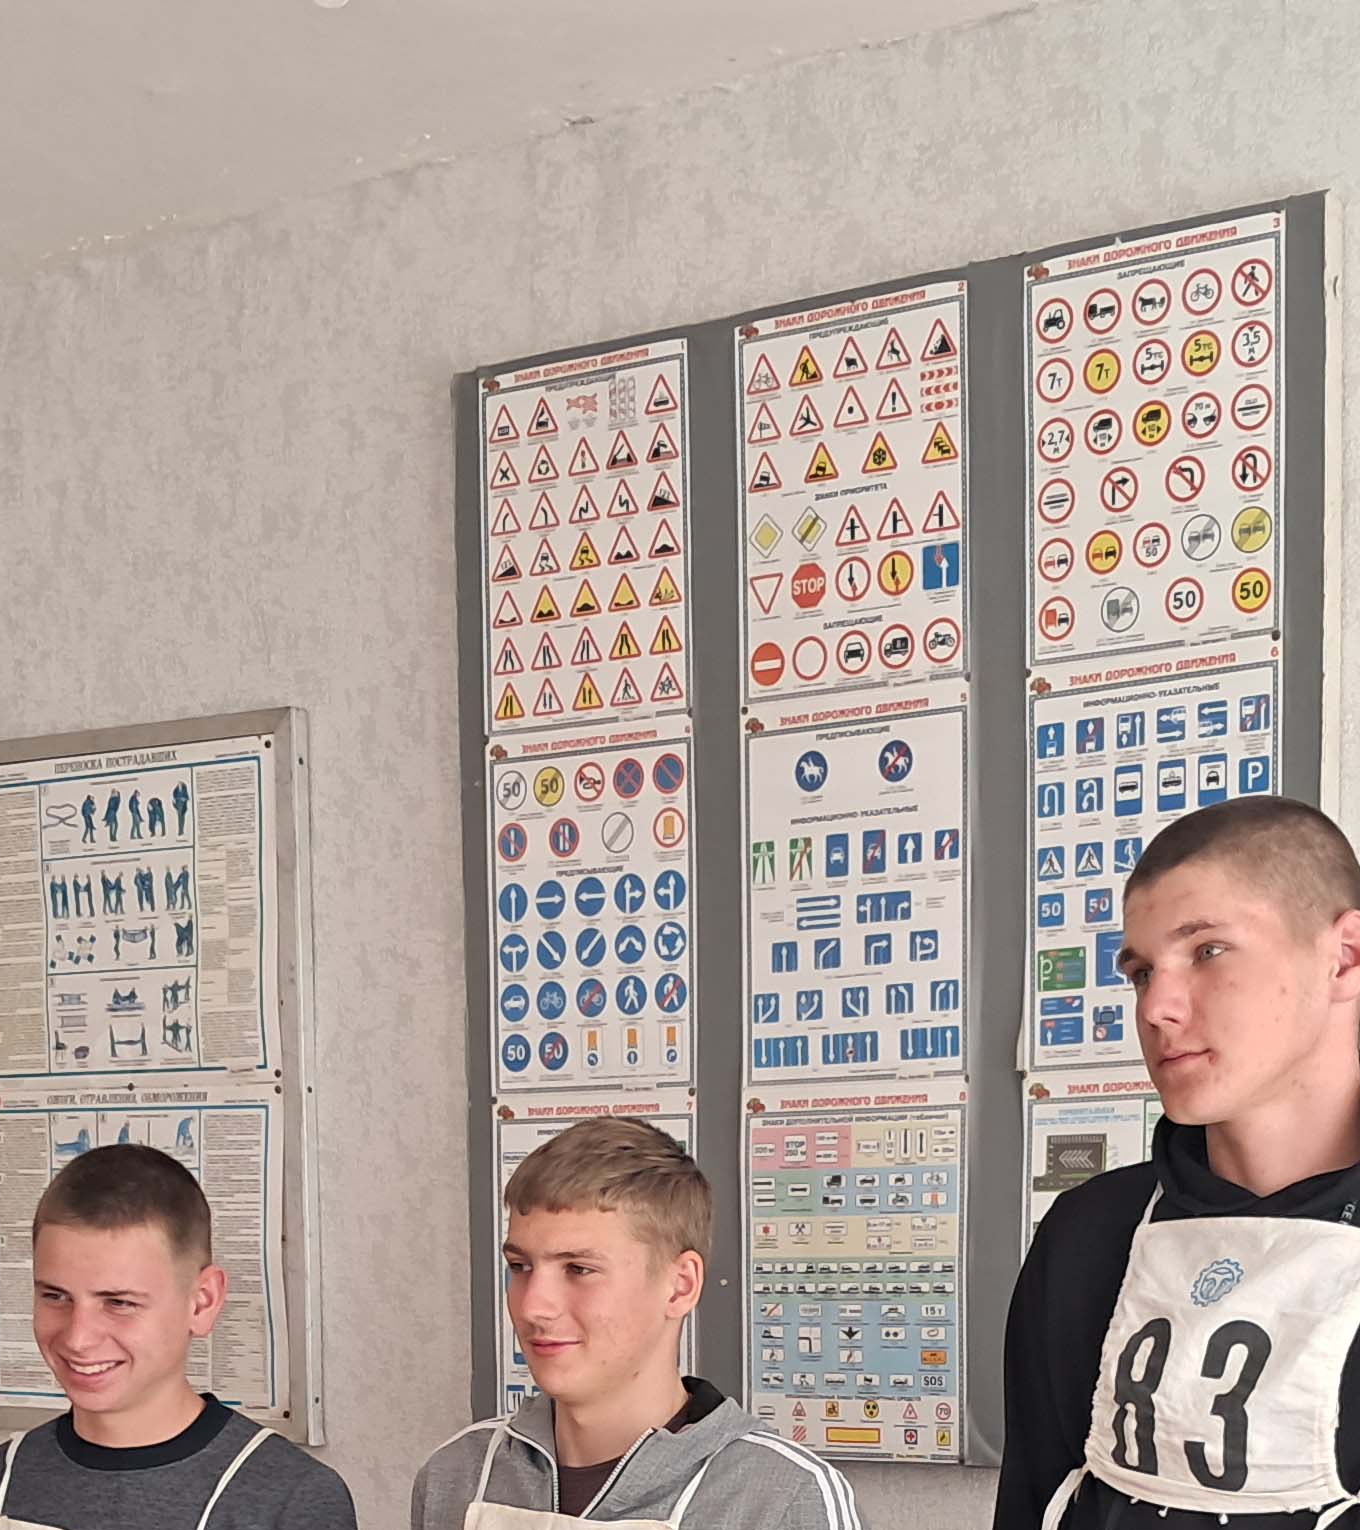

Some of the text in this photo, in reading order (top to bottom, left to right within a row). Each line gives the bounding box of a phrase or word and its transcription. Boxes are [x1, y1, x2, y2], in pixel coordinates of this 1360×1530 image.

[1272, 217, 1281, 228] 3
[1067, 225, 1238, 270] ЗНАКИ ДОРОЖНОГО ДВИЖЕНИЯ
[773, 289, 927, 330] ЗНАКИ ДОРОЖНОГО ДВИЖЕНИЯ
[792, 578, 825, 596] STOP
[1238, 579, 1264, 601] 50
[1172, 590, 1196, 610] 50
[1270, 646, 1279, 658] 6
[1069, 652, 1237, 687] ЗНАКИ ДОРОЖНОГО ДВИЖЕНИЯ
[779, 697, 930, 727] ЗНАКИ ДОРОЖНОГО ДВИЖЕНИЯ
[1246, 761, 1264, 790] P
[502, 781, 521, 798] 50
[540, 777, 559, 793] 50
[1041, 901, 1062, 918] 50
[506, 1044, 526, 1062] 50
[1067, 1083, 1100, 1095] ЗНАКИ
[779, 1093, 929, 1110] ЗНАКИ ДОРОЖНОГО ДВИЖЕНИЯ
[923, 1375, 944, 1387] SOS
[1111, 1317, 1273, 1493] 83
